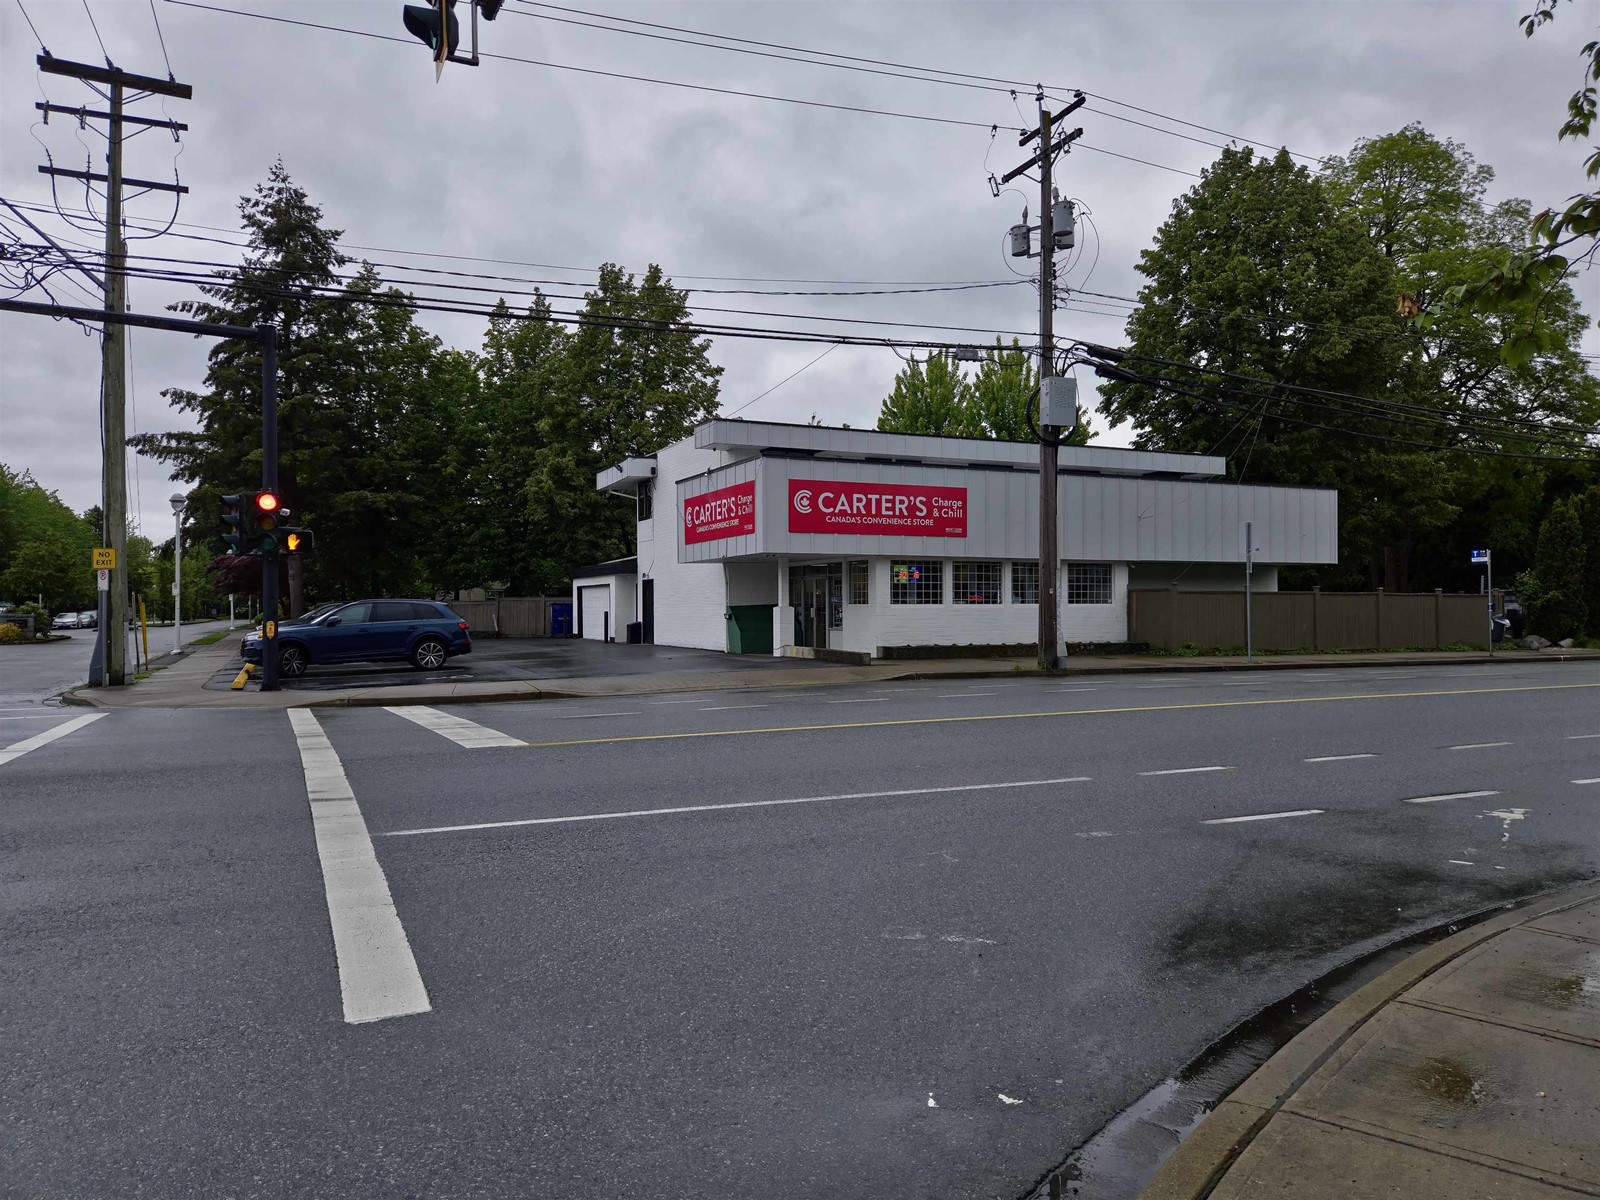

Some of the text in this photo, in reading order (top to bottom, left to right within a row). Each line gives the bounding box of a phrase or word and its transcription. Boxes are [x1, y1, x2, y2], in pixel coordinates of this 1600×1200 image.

[818, 492, 927, 516] CARTER'S
[932, 497, 962, 509] Charge
[693, 496, 736, 525] CARTER'S
[933, 508, 963, 518] & Chill
[825, 515, 934, 526] CANADA'S CONVENIENCE STORE
